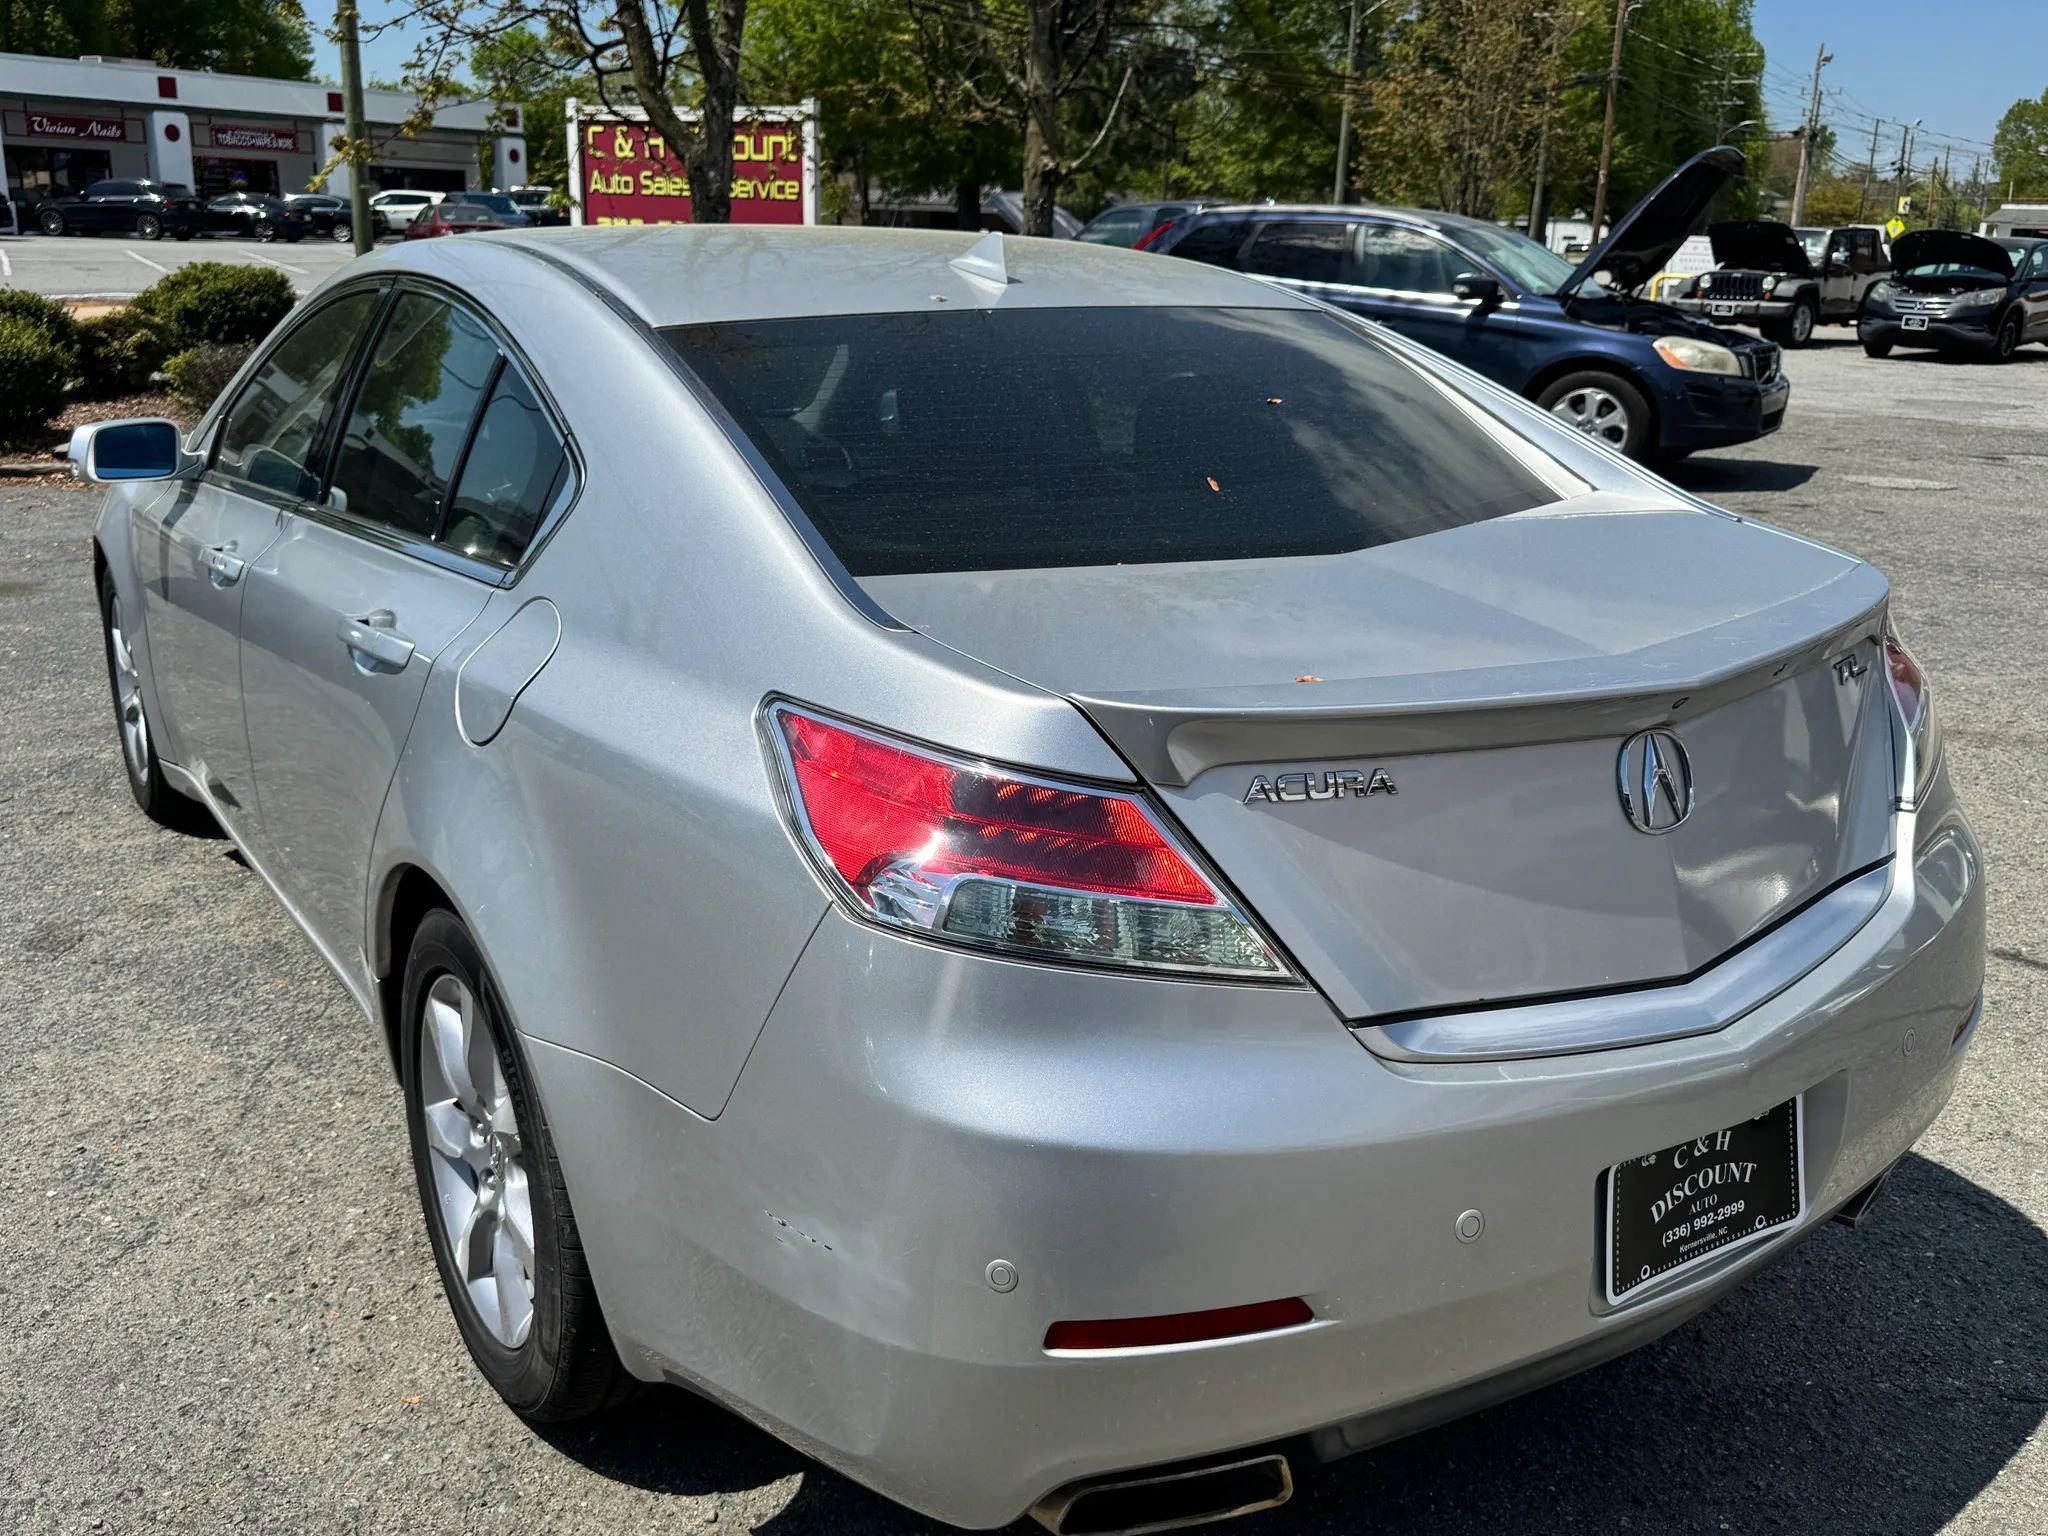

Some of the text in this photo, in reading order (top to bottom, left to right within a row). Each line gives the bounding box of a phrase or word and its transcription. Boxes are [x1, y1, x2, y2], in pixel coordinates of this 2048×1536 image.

[31, 116, 121, 137] Vivian Nails
[614, 126, 635, 159] &
[589, 169, 634, 195] Auto
[1832, 653, 1868, 686] TL
[1242, 768, 1399, 806] ACURA
[1673, 1130, 1732, 1169] C & H
[1650, 1162, 1757, 1224] DISCOUNT
[1688, 1194, 1718, 1215] AUTO
[1662, 1200, 1745, 1248] (336) 992-2999
[1718, 1226, 1729, 1237] NC
